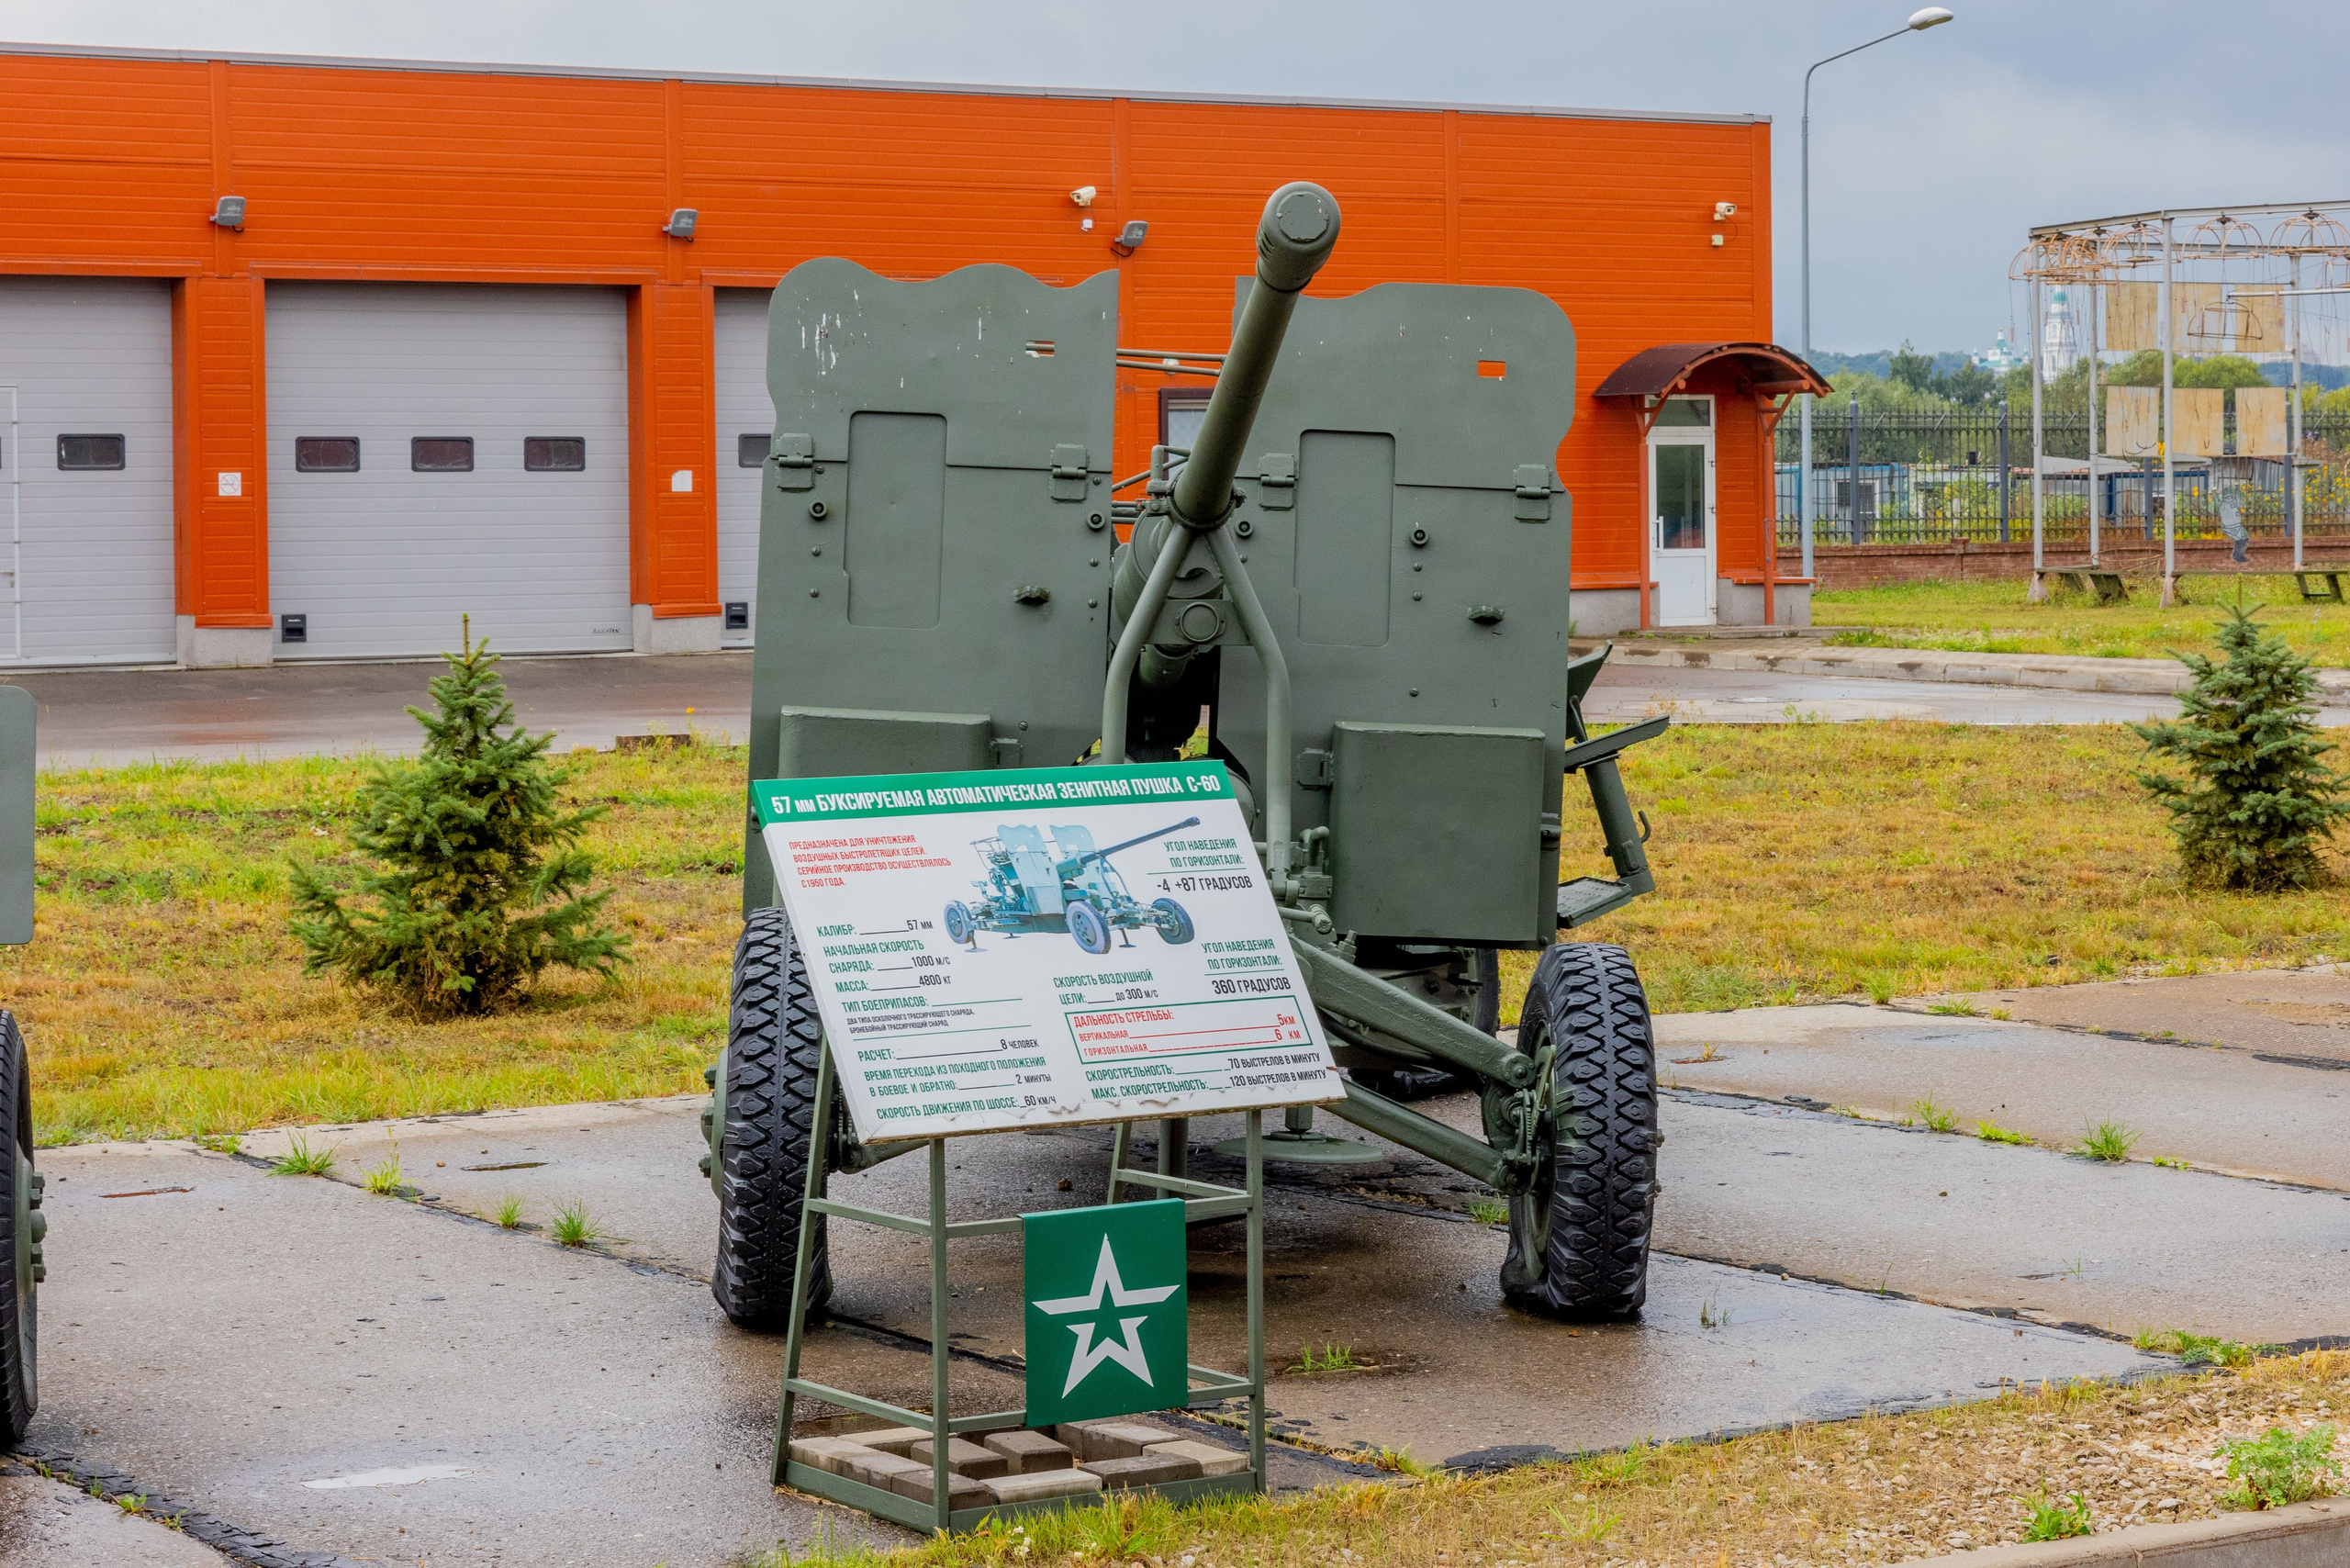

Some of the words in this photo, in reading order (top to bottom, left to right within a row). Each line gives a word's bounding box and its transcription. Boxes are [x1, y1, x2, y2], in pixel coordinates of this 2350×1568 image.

[771, 796, 791, 813] 57
[815, 790, 924, 812] БУКСИРУЕМАЯ
[927, 783, 1058, 806] АВТОМАТИЧЕСКАЯ
[1059, 779, 1133, 799] ЗЕНИТНАЯ
[1131, 777, 1184, 794] ПУШКА
[1186, 775, 1221, 792] С-60
[789, 839, 848, 850] ПРЕДНАЗНАЧЕНА
[849, 838, 864, 847] ДЛЯ
[865, 835, 916, 846] УНИЧТОЖЕНИЯ
[1164, 841, 1187, 853] УГОЛ
[1189, 838, 1237, 851] НАВЕДЕНИЯ
[793, 852, 839, 862] ВОЗДУШНЫХ
[841, 849, 901, 860] БЫСТРОЛЕТЯЩИХ
[901, 846, 926, 857] ЦЕЛЕЙ.
[1170, 857, 1183, 868] ПО
[1184, 854, 1245, 867] ГОРИЗОНТАЛИ:
[798, 865, 833, 875] СЕРИЙНОЕ
[834, 862, 887, 873] ПРОИЗВОДСТВО
[888, 858, 952, 870] ОСУЩЕСТВЛЯЛОСЬ
[825, 877, 846, 887] ГОДА.
[1157, 878, 1171, 892] -4
[1175, 877, 1197, 891] +87
[1199, 875, 1253, 890] ГРАДУСОВ
[817, 924, 856, 936] КАЛИБР:
[907, 920, 918, 931] 57
[823, 943, 878, 957] НАЧАЛЬНАЯ
[878, 939, 924, 954] СКОРОСТЬ
[1201, 942, 1225, 954] УГОЛ
[1225, 938, 1275, 952] НАВЕДЕНИЯ
[829, 961, 875, 974] СНАРЯДА:
[912, 956, 934, 968] 1000
[1208, 958, 1220, 970] ПО
[1221, 955, 1283, 969] ГОРИЗОНТАЛИ:
[835, 980, 870, 992] МАССА:
[919, 974, 942, 987] 4800
[1054, 975, 1097, 989] СКОРОСТЬ
[1099, 969, 1154, 984] ВОЗДУШНОЙ
[1212, 979, 1236, 995] 360
[1238, 977, 1291, 992] ГРАДУСОВ
[842, 1002, 860, 1013] ТИП
[862, 996, 929, 1011] БОЕПРИПАСОВ:
[1059, 992, 1087, 1006] ЦЕЛИ:
[1125, 989, 1144, 1001] 300
[872, 1014, 907, 1023] ОСКОЛОЧНОГО
[908, 1010, 949, 1020] ТРАССИРУЮЩЕГО
[950, 1009, 975, 1017] СНАРЯДА,
[1074, 1014, 1125, 1028] ДАЛЬНОСТЬ
[1125, 1009, 1175, 1023] СТРЕЛЬБЫ:
[849, 1024, 887, 1034] БРОНЕБОЙНЫЙ
[887, 1021, 927, 1030] ТРАССИРУЮЩИЙ
[928, 1019, 948, 1027] СНАРЯД
[1080, 1029, 1129, 1042] ВЕРТИКАЛЬНАЯ
[1083, 1043, 1148, 1057] ГОРИЗОНТАЛЬНАЯ
[1275, 1029, 1282, 1041] 6
[857, 1049, 895, 1061] РАСЧЕТ:
[1000, 1038, 1008, 1050] 8
[1009, 1039, 1039, 1049] ЧЕЛОВЕК
[864, 1069, 892, 1081] ВРЕМЯ
[893, 1066, 935, 1079] ПЕРЕХОДА
[937, 1065, 947, 1075] ИЗ
[948, 1060, 996, 1074] ПОХОДНОГО
[997, 1057, 1046, 1070] ПОЛОЖЕНИЯ
[1086, 1064, 1175, 1082] СКОРОСТРЕЛЬНОСТЬ:
[1229, 1058, 1241, 1069] 70
[1241, 1056, 1283, 1068] ВЫСТРЕЛОВ
[1283, 1055, 1291, 1065] В
[1292, 1052, 1320, 1065] МИНУТУ
[869, 1086, 876, 1096] В
[878, 1083, 909, 1096] БОЕВОЕ
[912, 1082, 918, 1092] И
[920, 1080, 958, 1092] ОБРАТНО:
[1017, 1074, 1023, 1084] 2
[1024, 1073, 1051, 1083] МИНУТЫ
[1091, 1085, 1119, 1099] МАКС.
[1121, 1079, 1209, 1097] СКОРОСТРЕЛЬНОСТЬ:
[1230, 1076, 1247, 1087] 120
[1247, 1072, 1290, 1085] ВЫСТРЕЛОВ
[1291, 1071, 1296, 1082] В
[1298, 1069, 1326, 1081] МИНУТУ
[876, 1104, 921, 1119] СКОРОСТЬ
[923, 1102, 971, 1116] ДВИЖЕНИЯ
[973, 1100, 985, 1113] ПО
[987, 1097, 1019, 1110] ШОССЕ:
[1024, 1095, 1035, 1106] 60
